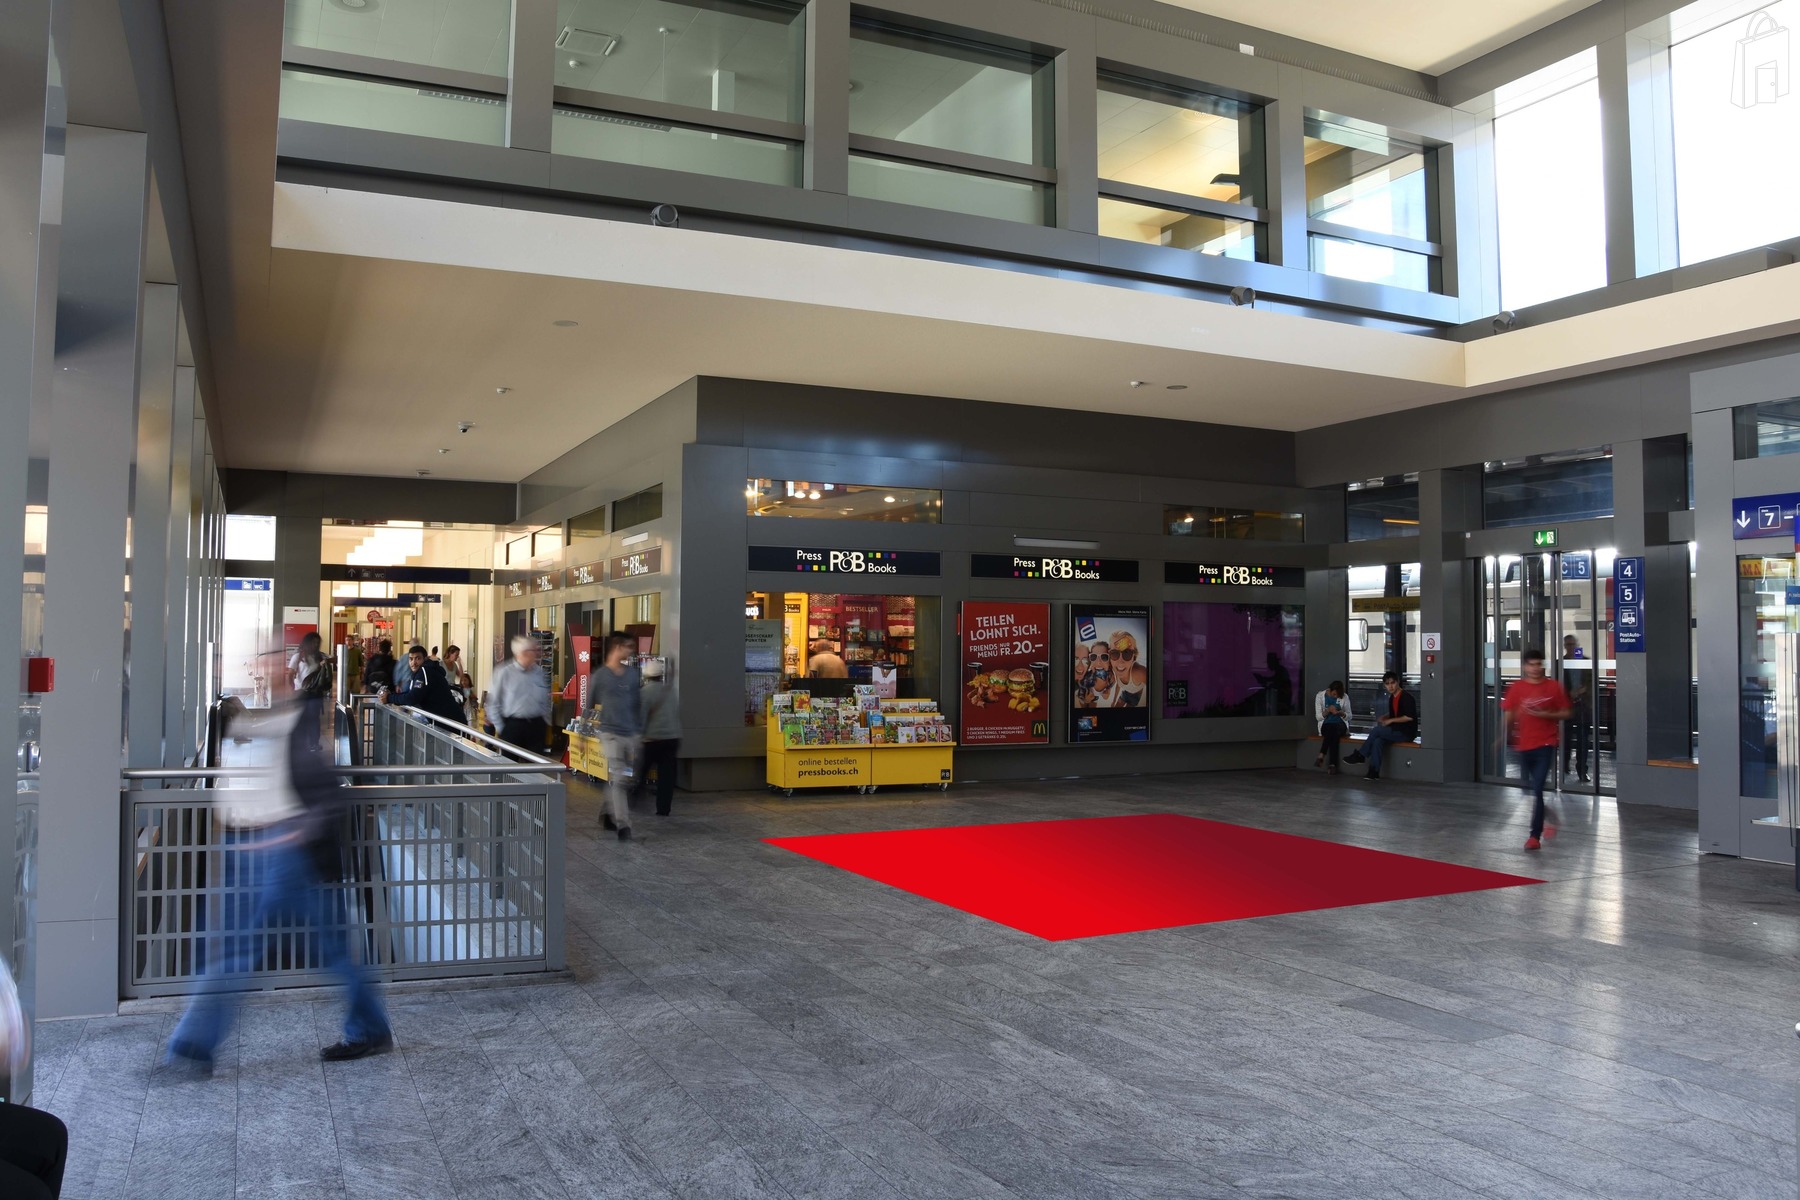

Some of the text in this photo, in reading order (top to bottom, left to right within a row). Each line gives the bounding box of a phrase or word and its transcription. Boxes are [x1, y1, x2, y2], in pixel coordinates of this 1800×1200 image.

[1764, 513, 1775, 526] 7
[796, 550, 897, 574] Press P&B Books
[1013, 557, 1100, 580] Press P&B Books
[1578, 561, 1586, 575] 5
[1199, 565, 1273, 586] Press P&B Books
[1623, 565, 1633, 577] 4
[1624, 588, 1633, 601] 5
[976, 614, 1015, 628] TEILEN
[1608, 622, 1615, 632] 2
[970, 624, 1041, 641] LOHNT SICH.
[969, 643, 998, 653] FRIENDS
[580, 674, 588, 709] SWISSLOS
[798, 757, 857, 766] online bestellen
[798, 767, 859, 779] pressbooks.ch
